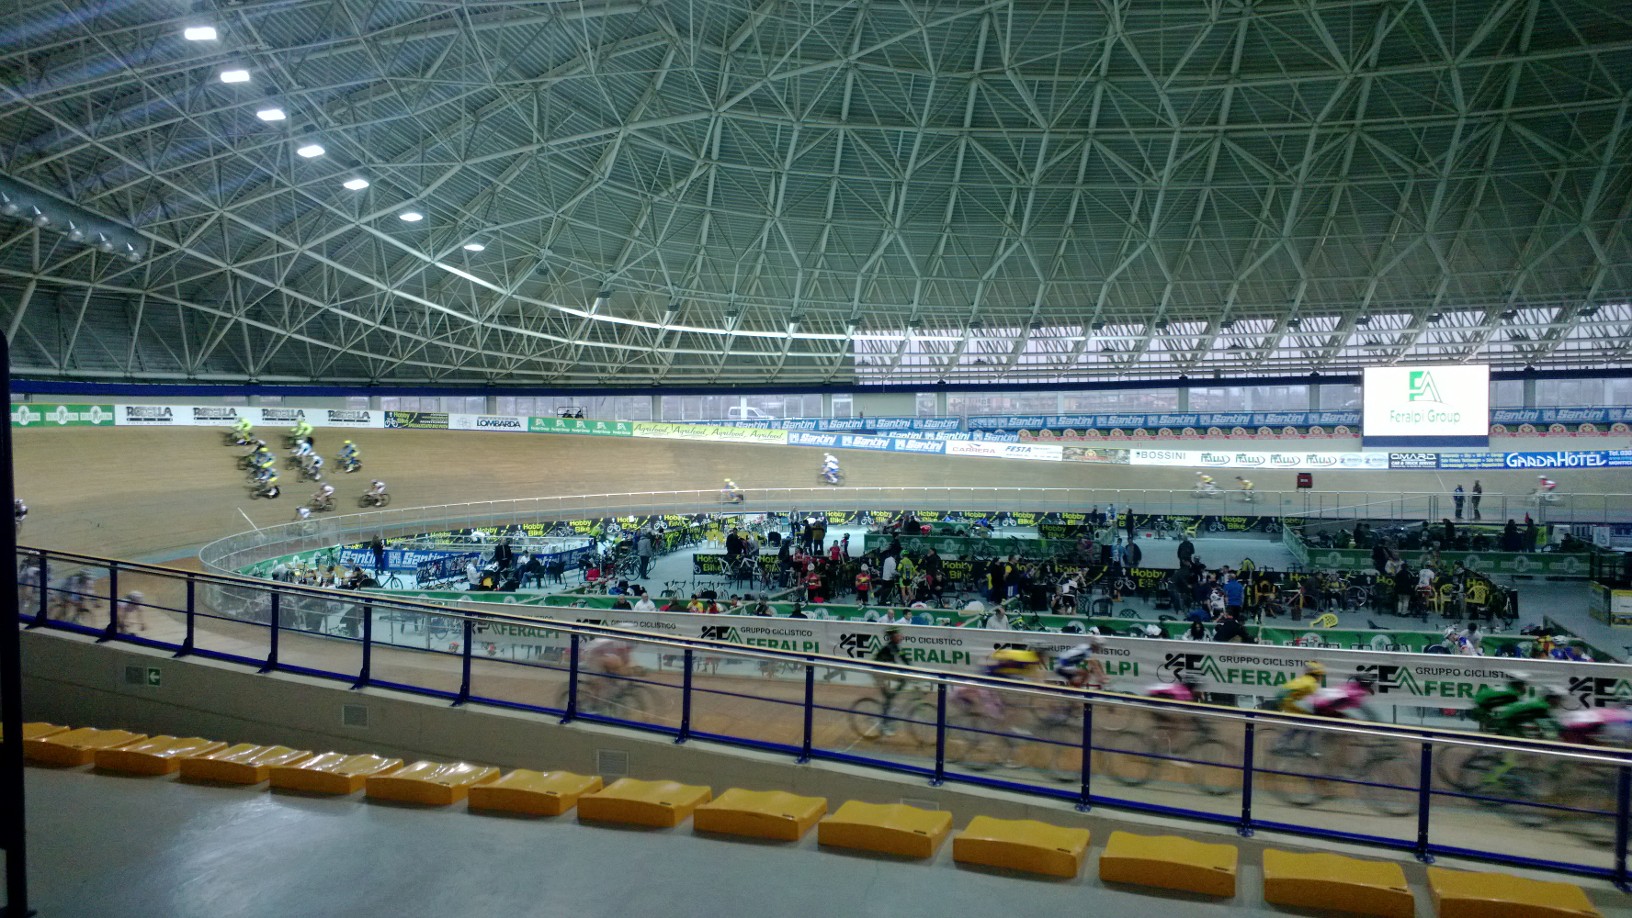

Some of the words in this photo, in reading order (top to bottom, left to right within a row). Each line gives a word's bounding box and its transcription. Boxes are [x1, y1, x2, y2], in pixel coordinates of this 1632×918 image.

[1390, 410, 1424, 424] Feralpi
[1428, 410, 1460, 424] Group
[477, 419, 520, 428] LOMBARDA
[1130, 568, 1166, 578] Hobby
[741, 626, 770, 634] GRUPPO
[918, 636, 962, 646] CICLISTICO
[1219, 656, 1260, 664] GRUPPO
[1416, 666, 1460, 676] GRUPPO
